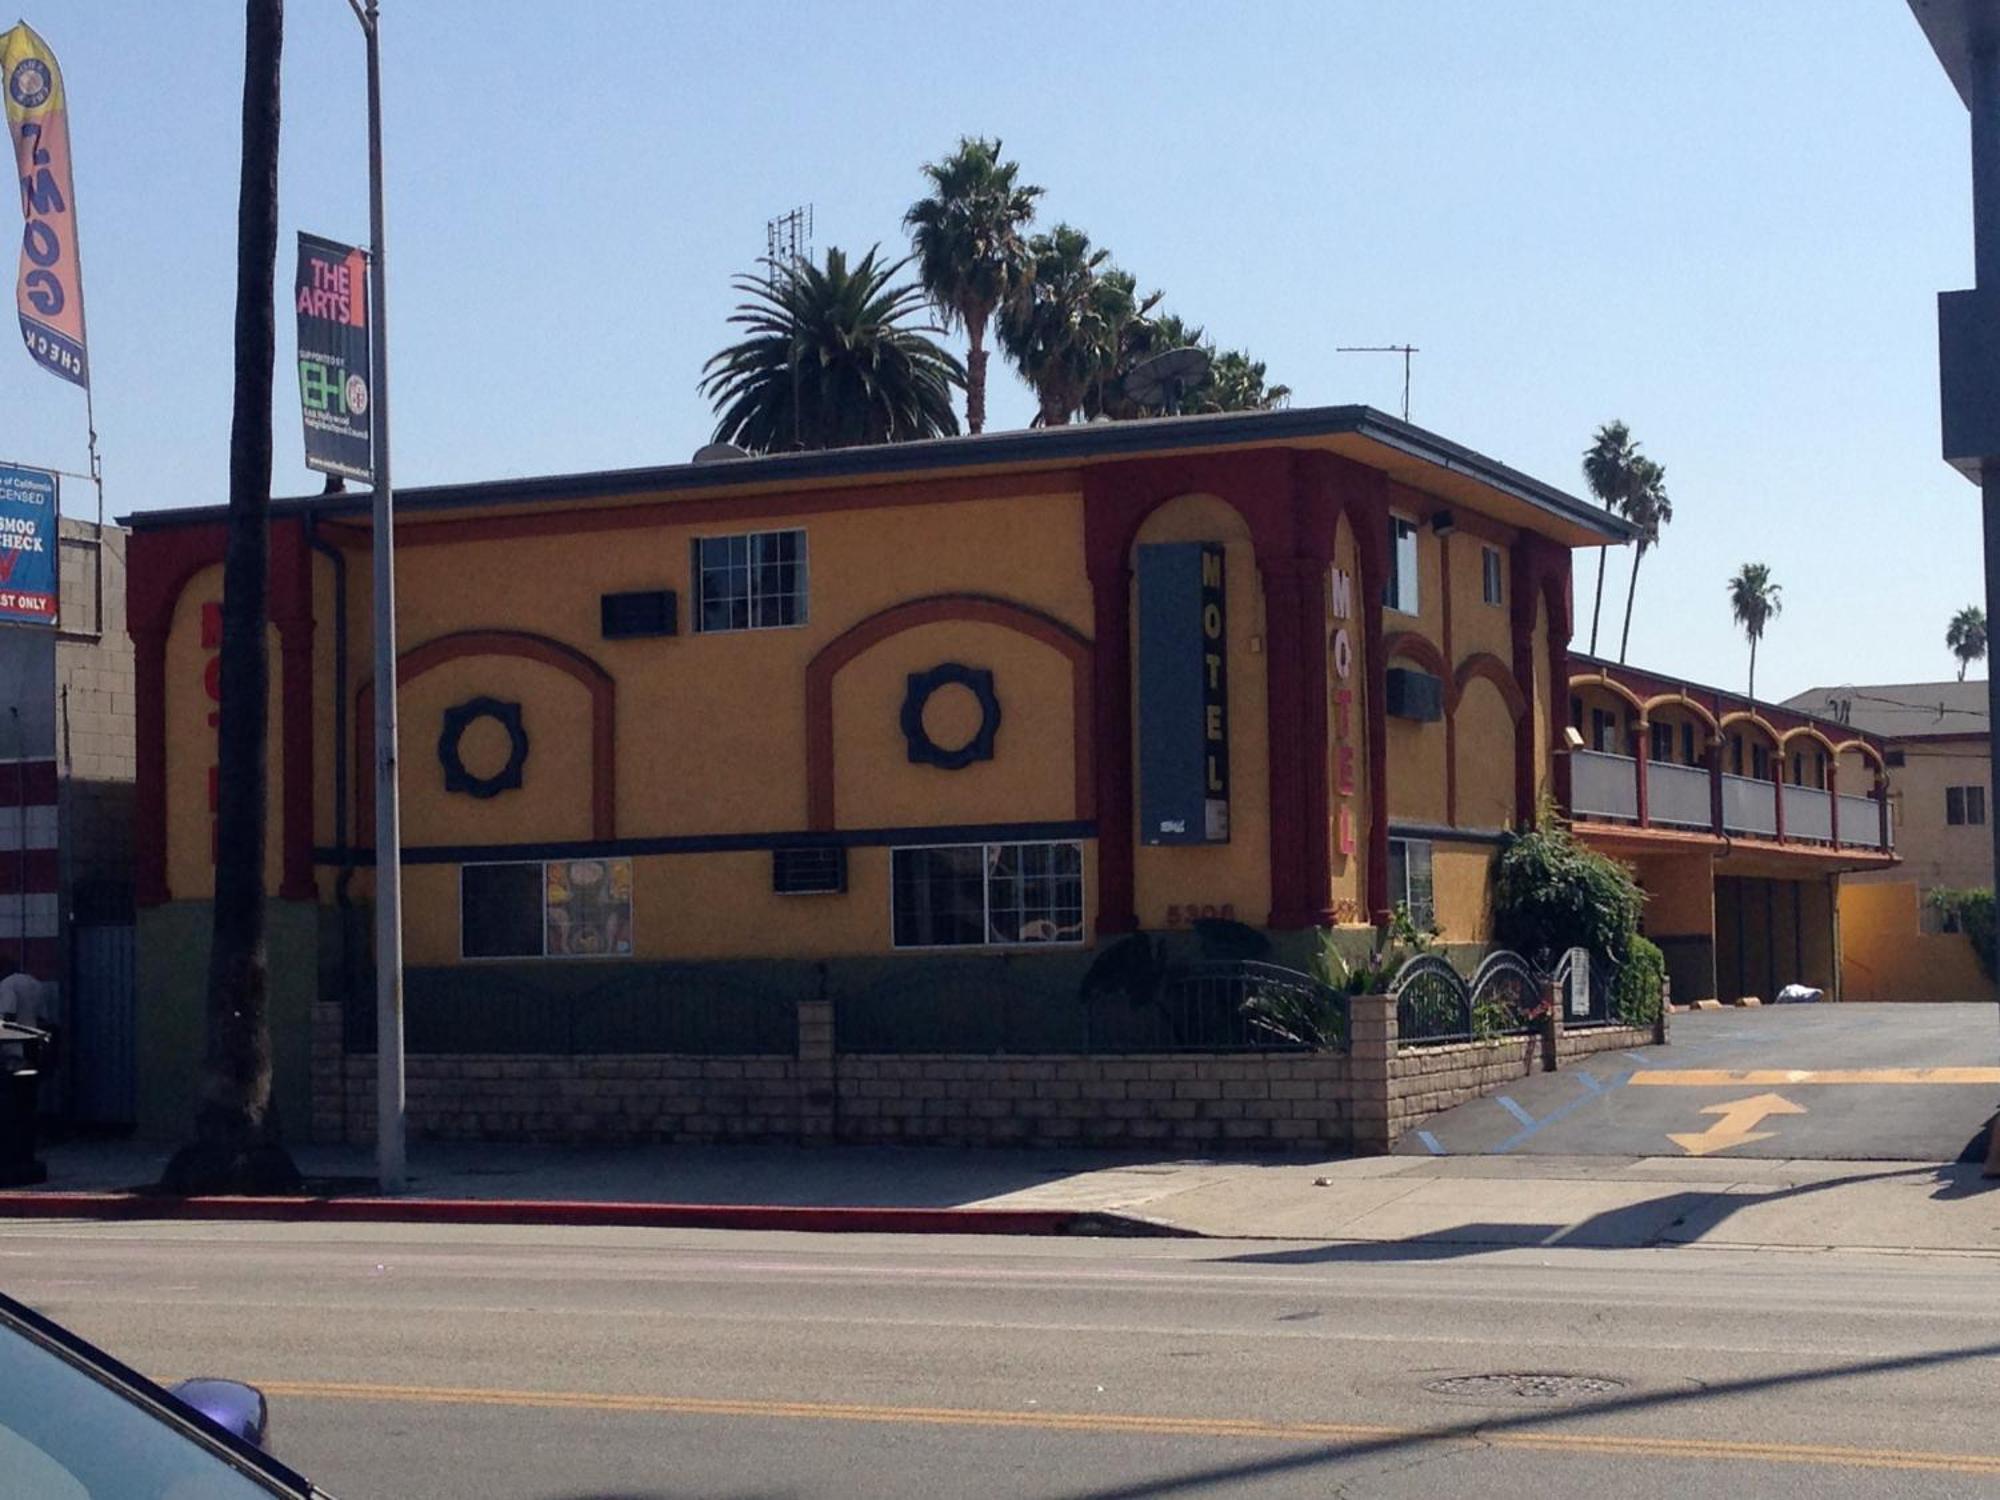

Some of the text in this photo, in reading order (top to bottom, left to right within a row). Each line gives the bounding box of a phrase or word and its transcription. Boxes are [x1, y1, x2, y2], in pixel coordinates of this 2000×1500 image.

[310, 256, 350, 296] THE
[297, 285, 350, 325] ARTS
[18, 595, 47, 611] ONLY
[1202, 551, 1223, 791] MOTEL
[1331, 567, 1357, 856] MOTEL
